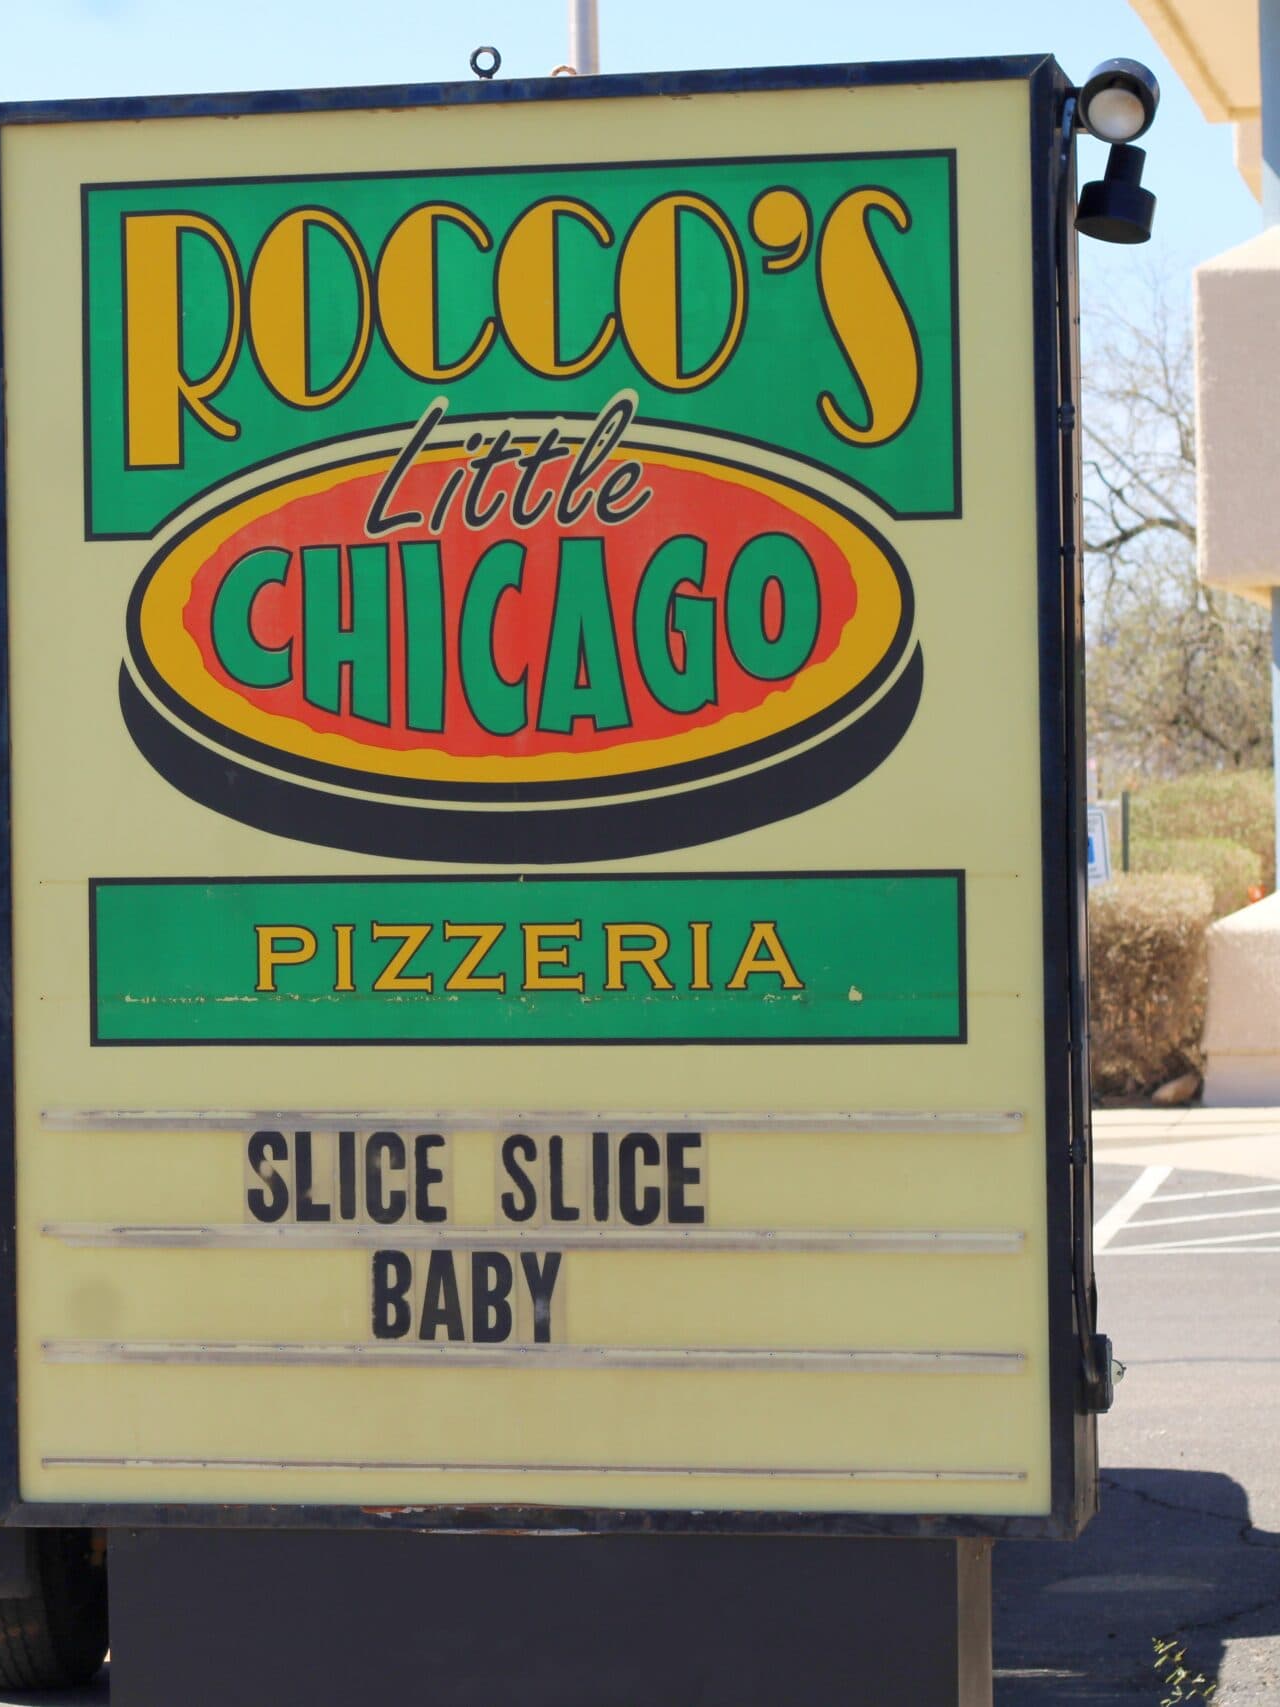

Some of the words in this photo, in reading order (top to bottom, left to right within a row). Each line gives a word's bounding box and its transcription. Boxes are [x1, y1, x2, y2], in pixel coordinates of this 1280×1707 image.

[121, 185, 923, 471] ROCCO'S
[365, 391, 653, 536] Little
[210, 531, 821, 736] CHICAGO
[254, 920, 805, 994] PIZZERIA
[247, 1131, 448, 1224] SLICE
[501, 1132, 705, 1226] SLICE
[371, 1249, 562, 1343] BABY
